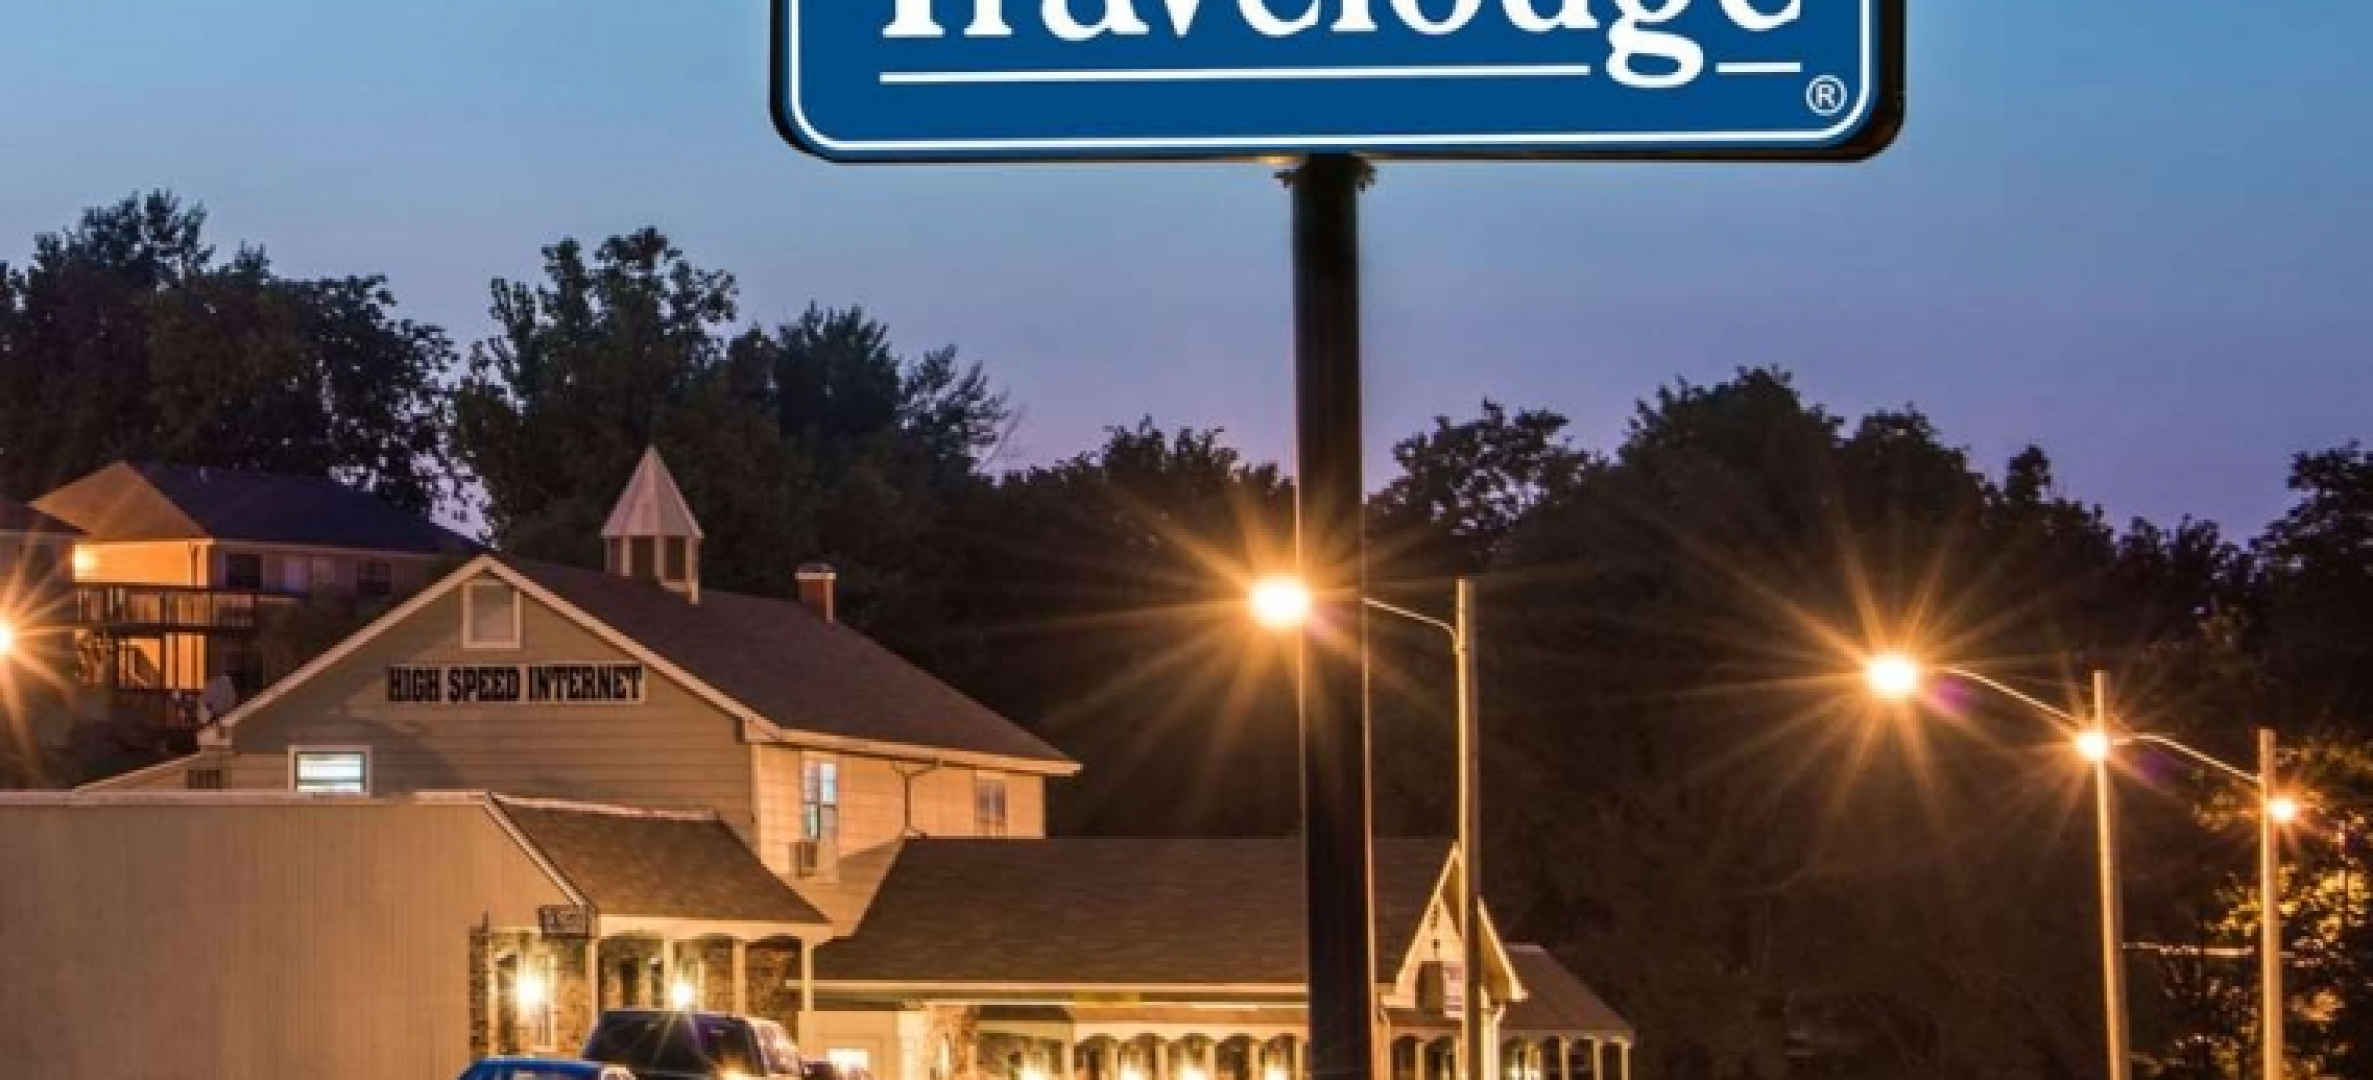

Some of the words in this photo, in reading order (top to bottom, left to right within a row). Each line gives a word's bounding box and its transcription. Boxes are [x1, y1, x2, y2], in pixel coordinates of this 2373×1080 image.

[387, 665, 442, 702] HIGH
[447, 665, 520, 703] SPEED
[528, 664, 643, 701] INTERNET
